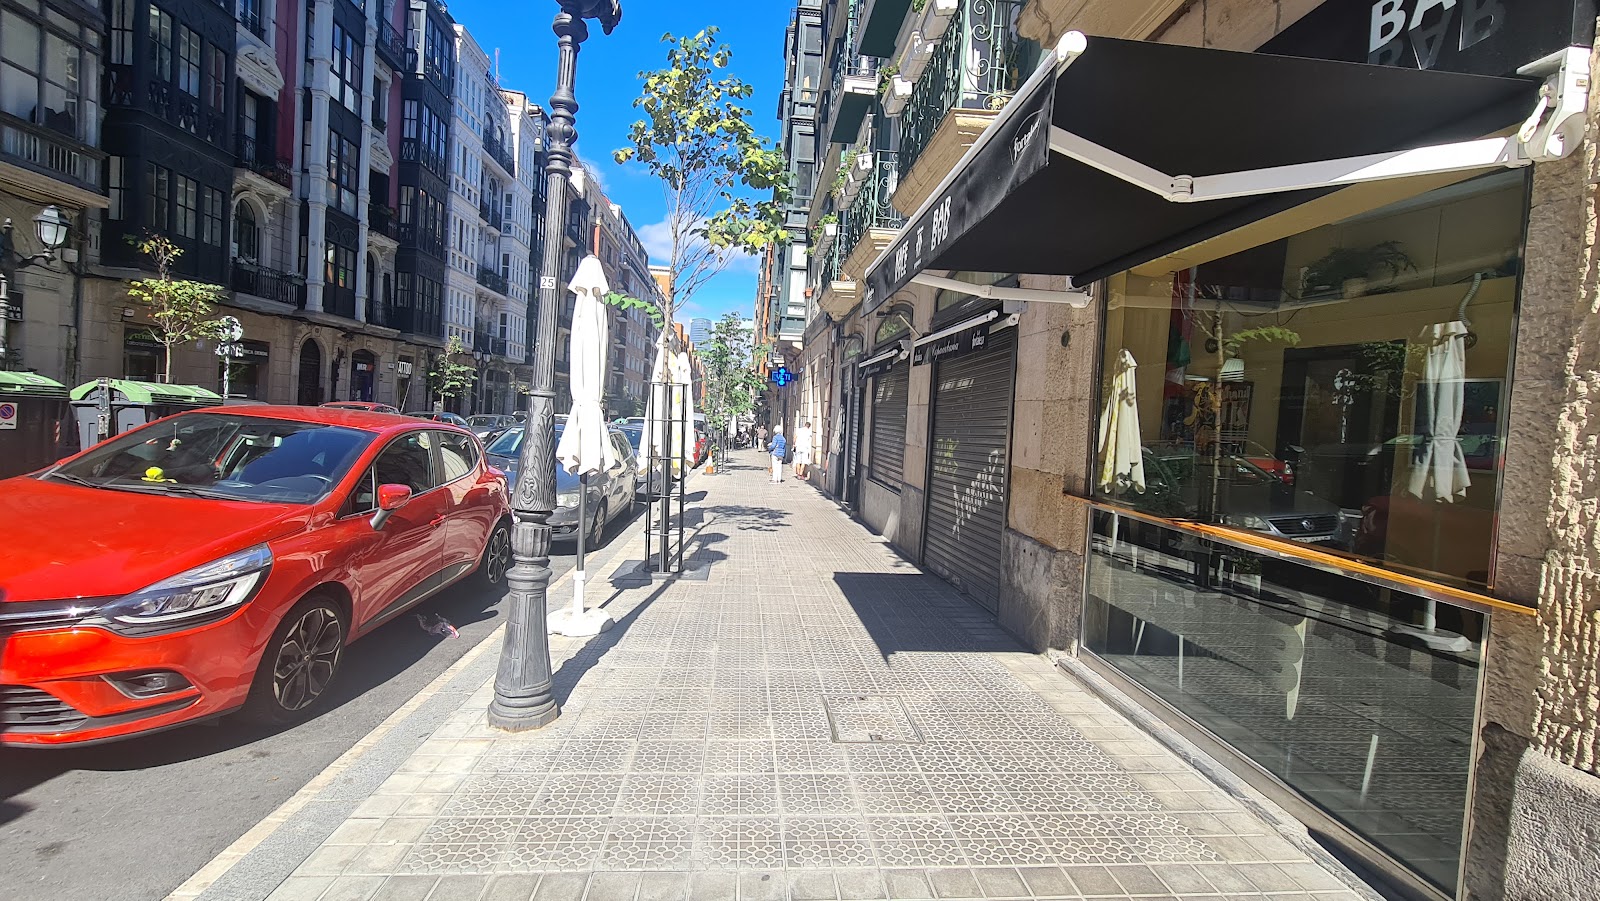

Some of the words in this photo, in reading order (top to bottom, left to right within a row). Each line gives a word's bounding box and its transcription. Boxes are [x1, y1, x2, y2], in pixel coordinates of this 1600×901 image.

[931, 195, 952, 243] BAR
[541, 277, 554, 288] 25
[397, 361, 412, 375] ATTOO
